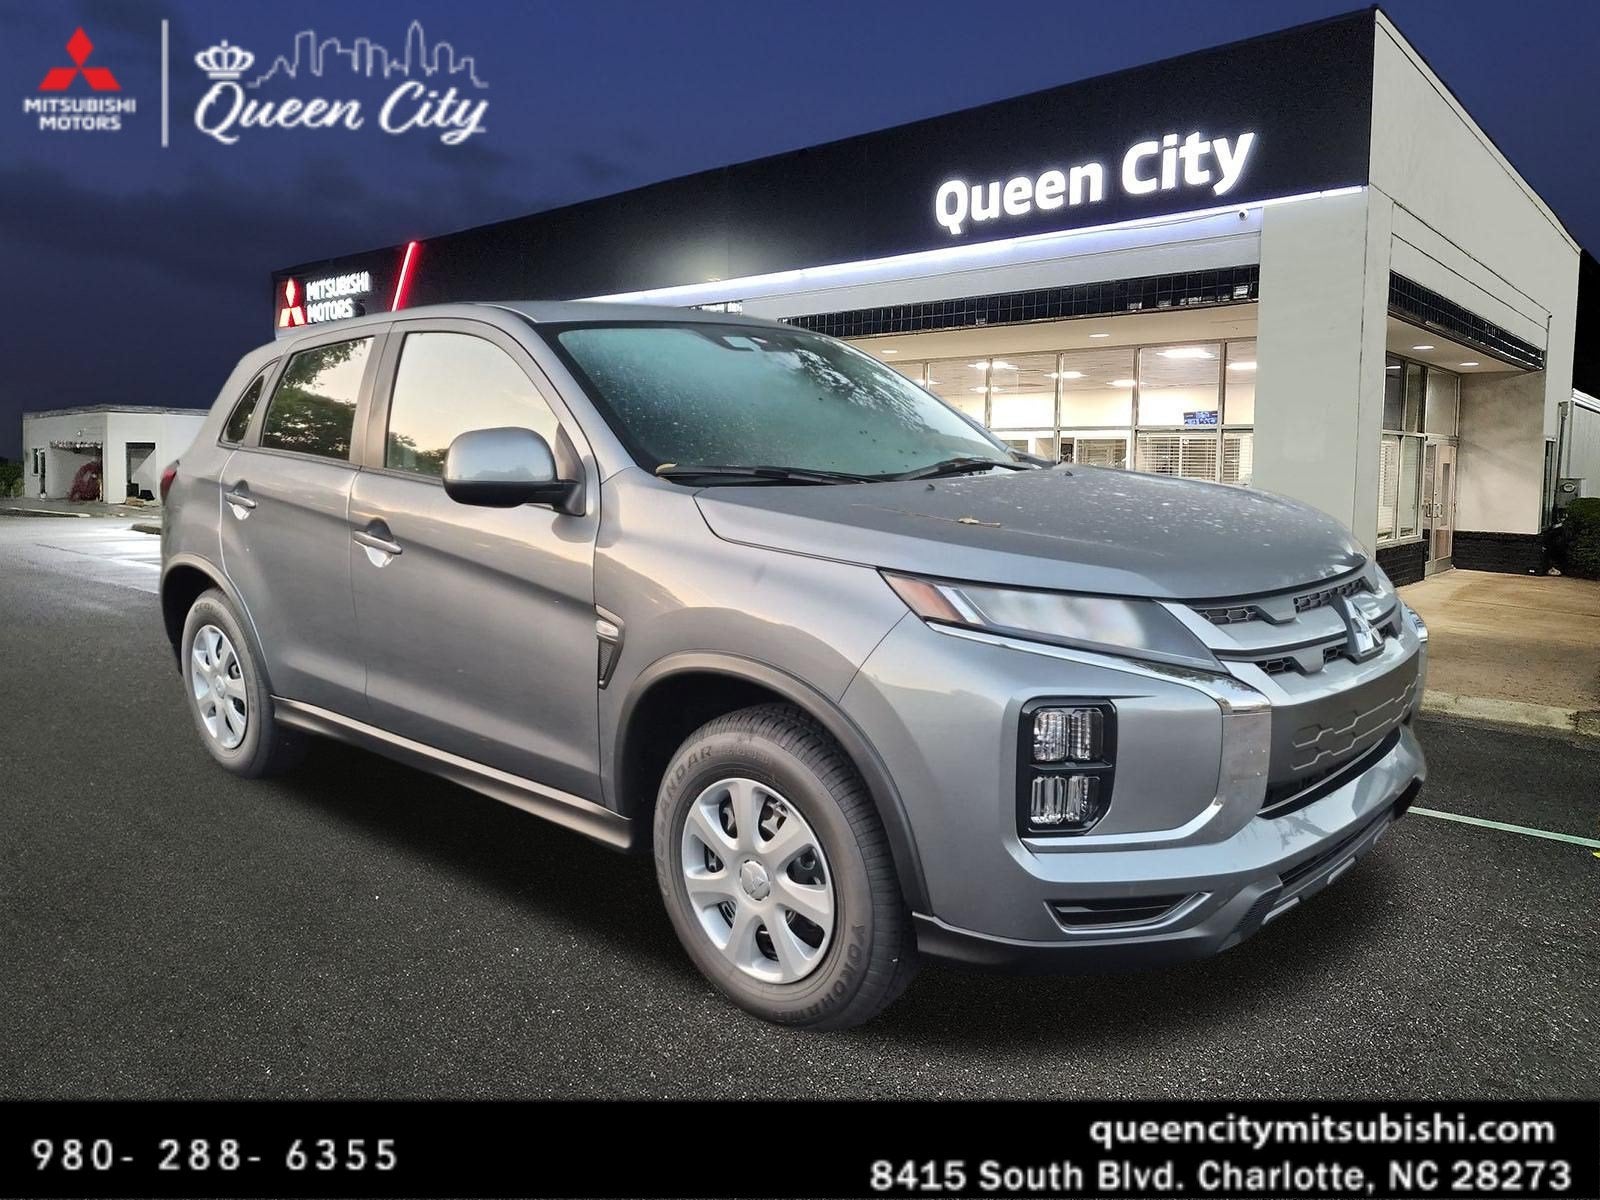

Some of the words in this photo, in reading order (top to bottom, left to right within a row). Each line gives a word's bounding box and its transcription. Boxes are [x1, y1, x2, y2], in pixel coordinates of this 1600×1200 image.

[935, 161, 1104, 235] Queen
[1121, 131, 1255, 196] City
[306, 270, 370, 301] MITSUBISHI
[306, 297, 354, 324] MOTORS
